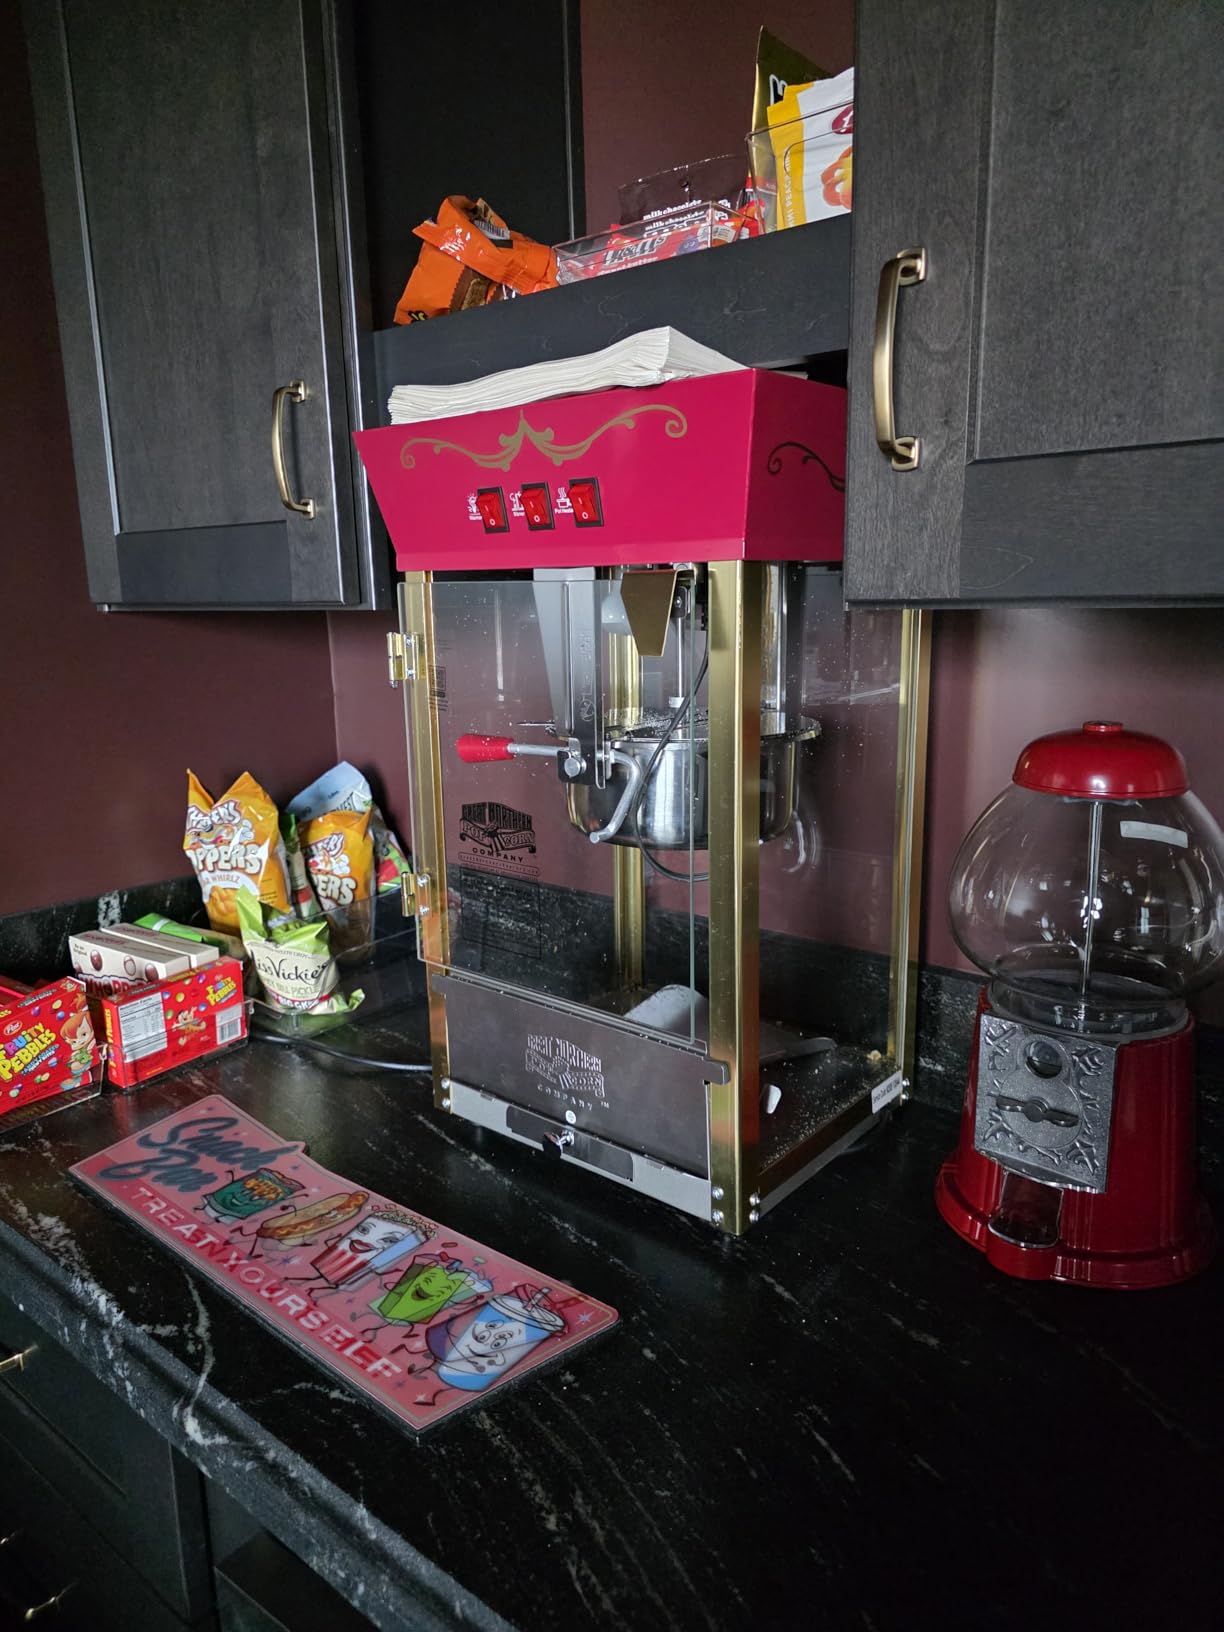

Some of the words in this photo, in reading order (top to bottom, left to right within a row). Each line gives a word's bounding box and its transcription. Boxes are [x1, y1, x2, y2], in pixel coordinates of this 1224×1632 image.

[462, 823, 488, 842] POP
[502, 831, 535, 847] CORN
[472, 846, 524, 863] COMPANY
[0, 1028, 56, 1082] PEBBLES
[555, 1037, 602, 1073] NORTHERN
[537, 1083, 593, 1111] COMPANY
[136, 1116, 300, 1171] Snack
[98, 1148, 218, 1193] Bar
[130, 1187, 220, 1249] TREAT
[222, 1250, 402, 1378] YOURSELF
